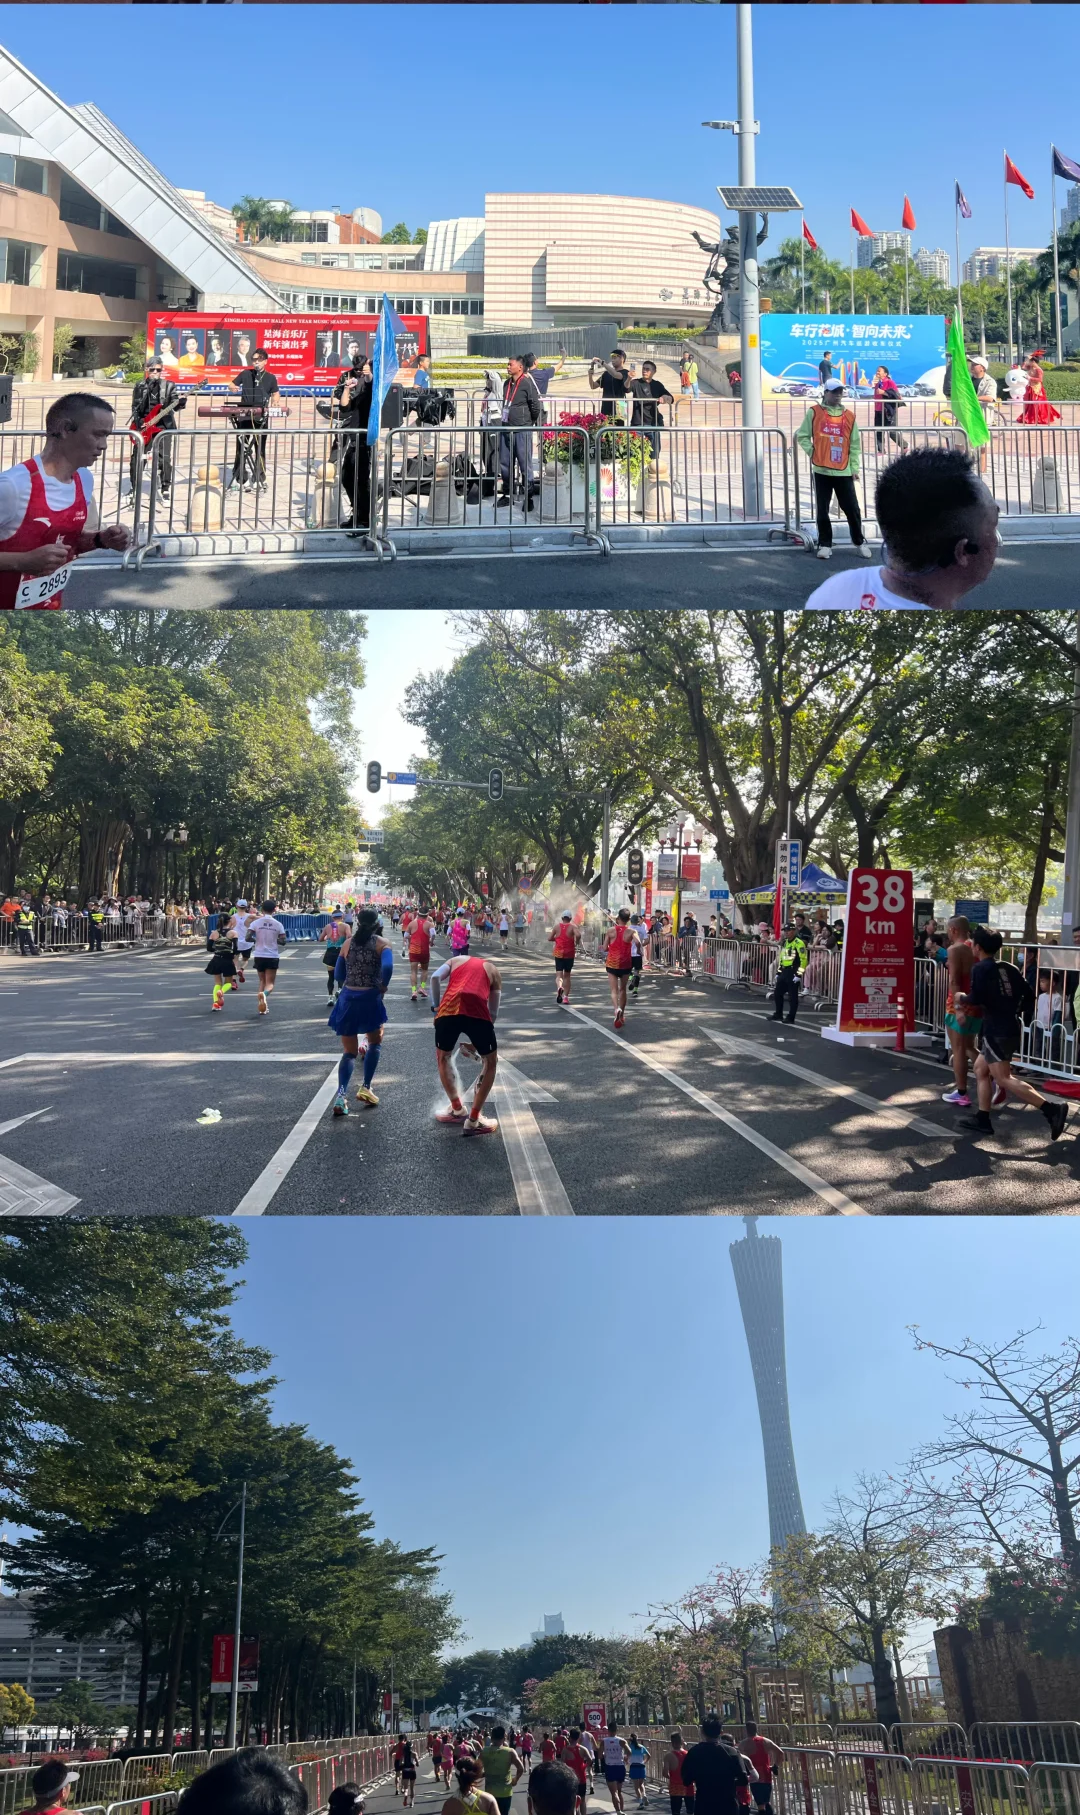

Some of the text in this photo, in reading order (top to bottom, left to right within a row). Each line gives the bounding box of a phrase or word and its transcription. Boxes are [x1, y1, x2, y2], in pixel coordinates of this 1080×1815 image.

[263, 329, 308, 339] 星海音乐厅
[263, 340, 308, 349] 新年演出季
[21, 569, 68, 597] C 2893
[855, 874, 905, 913] 38
[865, 916, 895, 935] km
[867, 1769, 879, 1815] 安全
[961, 1790, 973, 1808] 安
